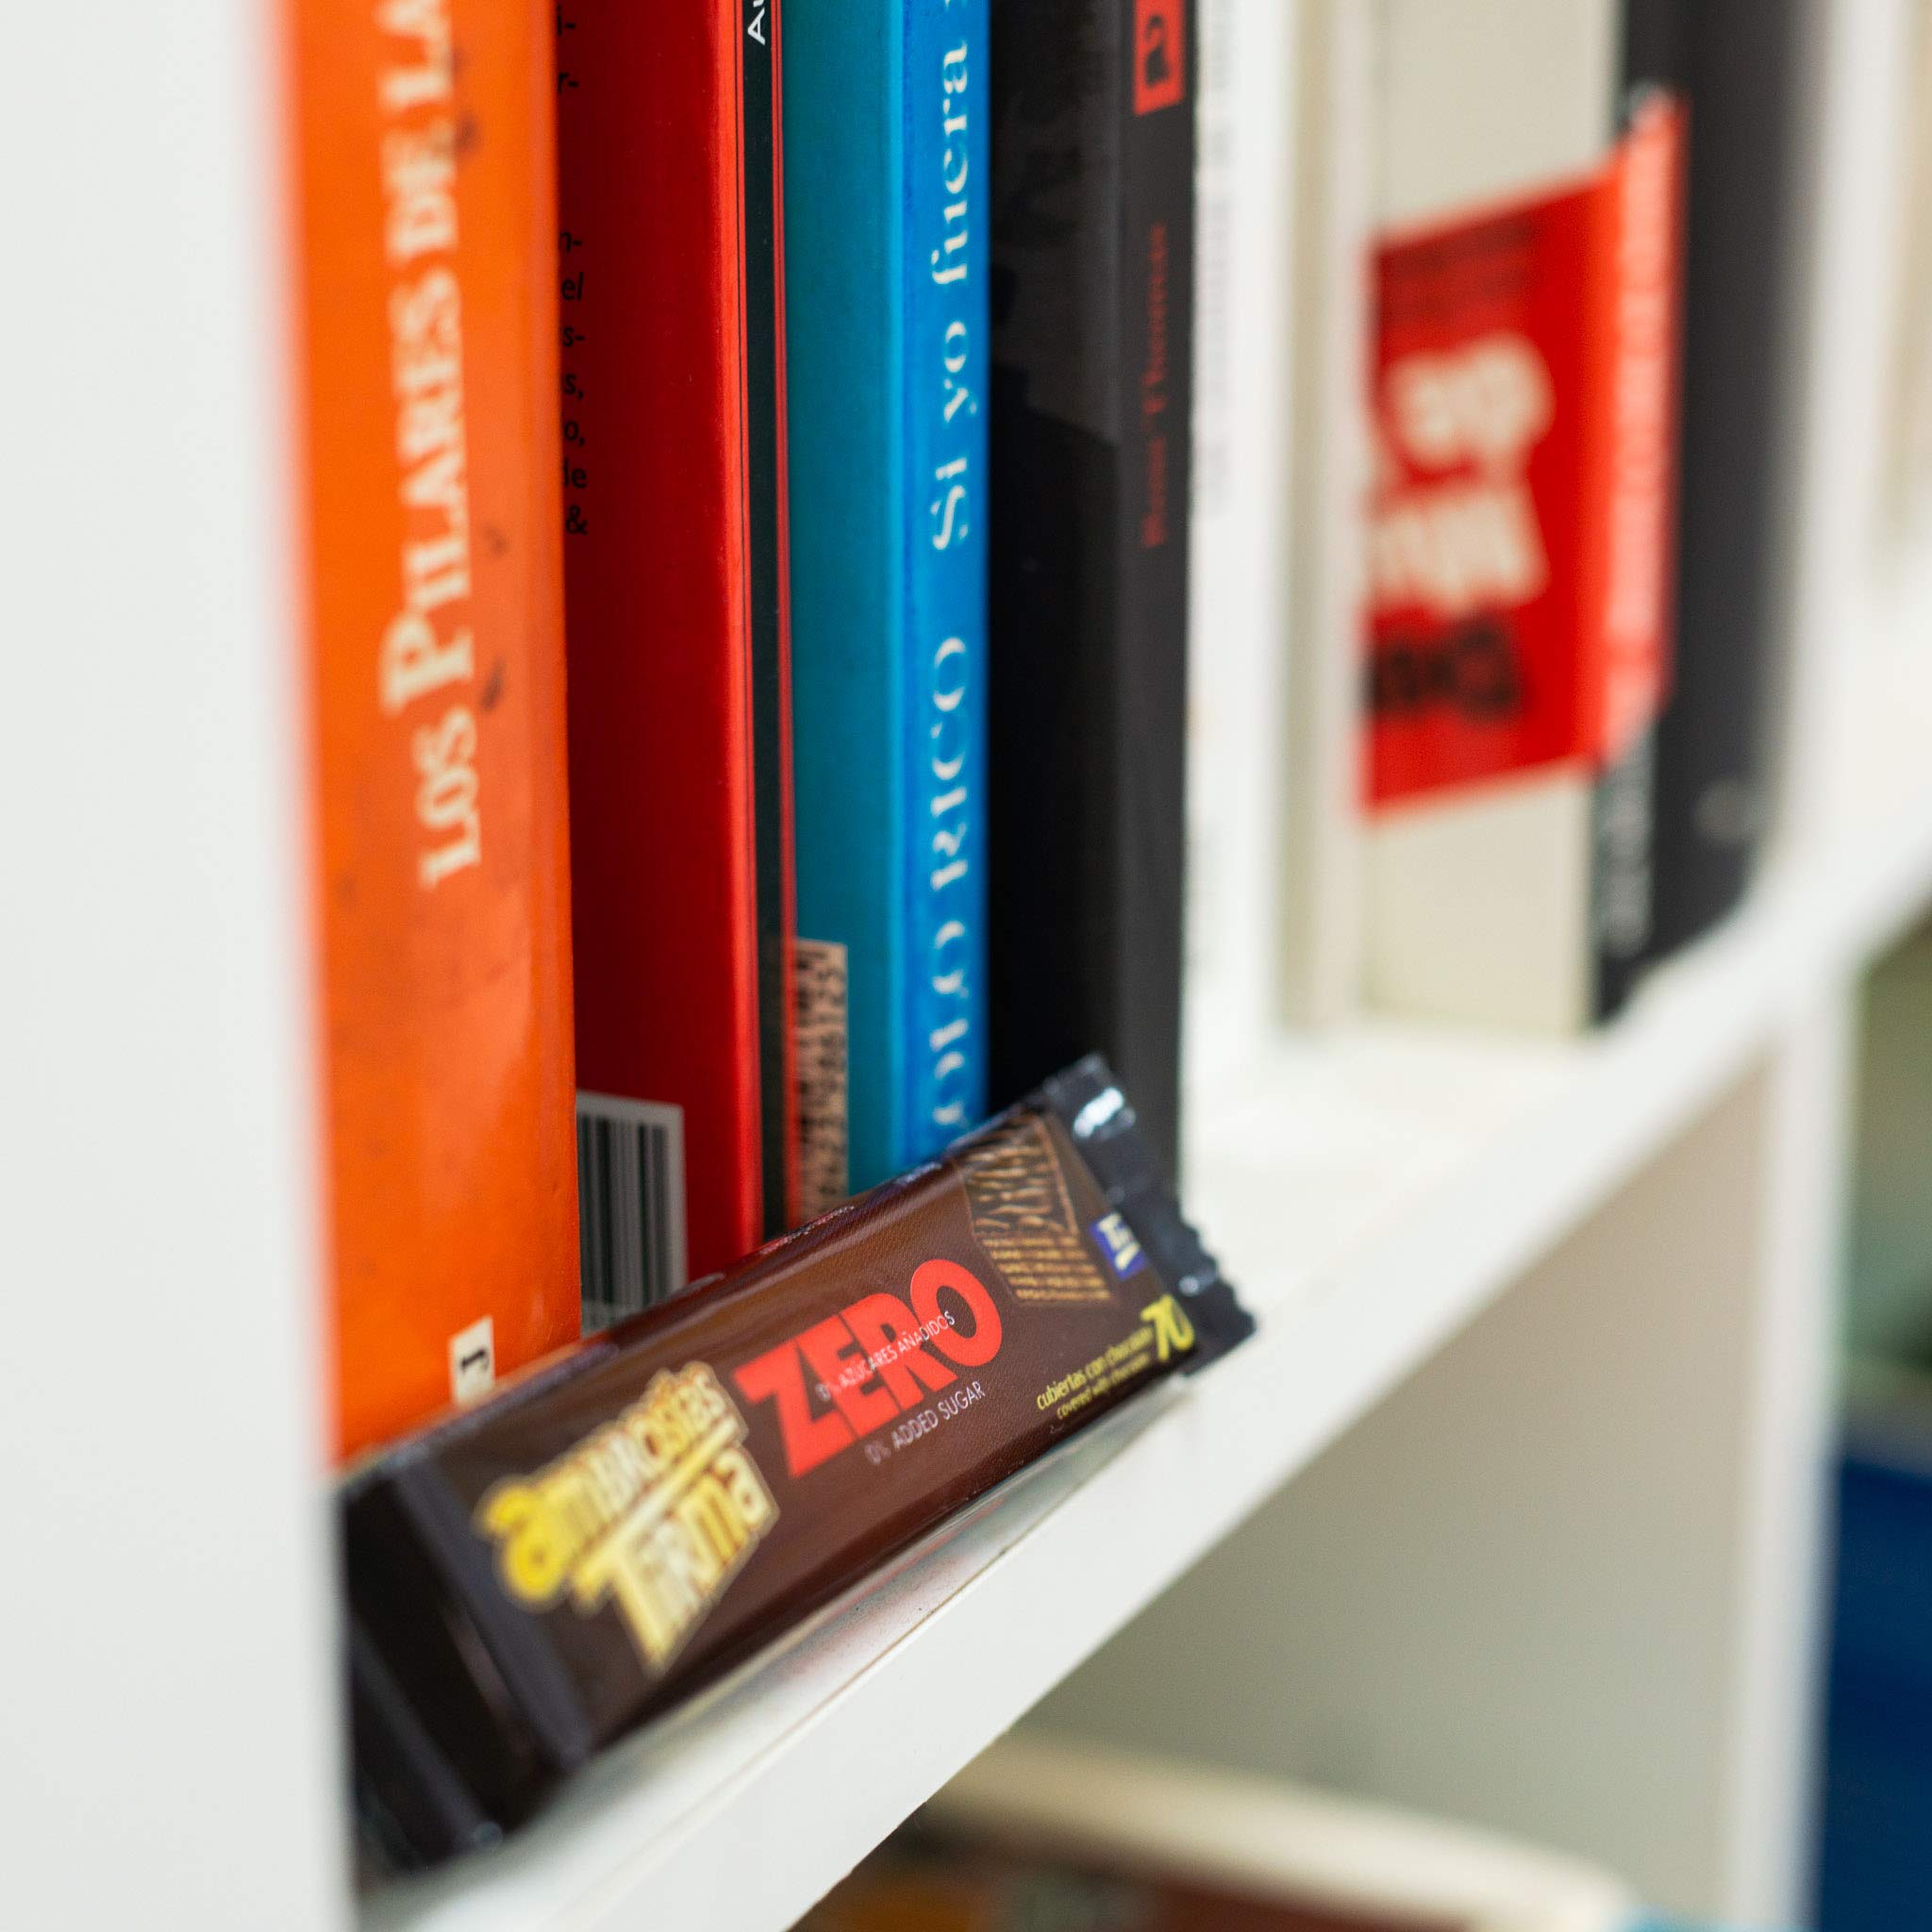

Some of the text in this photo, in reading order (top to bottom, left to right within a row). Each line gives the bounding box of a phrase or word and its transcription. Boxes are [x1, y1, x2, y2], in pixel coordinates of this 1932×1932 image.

[931, 40, 968, 286] fuera
[943, 320, 977, 423] yo
[380, 267, 474, 717] PILARES
[930, 637, 970, 1128] OLO RICO
[733, 1259, 1002, 1479] ZERO
[898, 1310, 956, 1354] AÑADIDOS
[1037, 1370, 1087, 1410] cubiertas
[891, 1409, 939, 1449] ADDED
[938, 1380, 986, 1421] SUGAR
